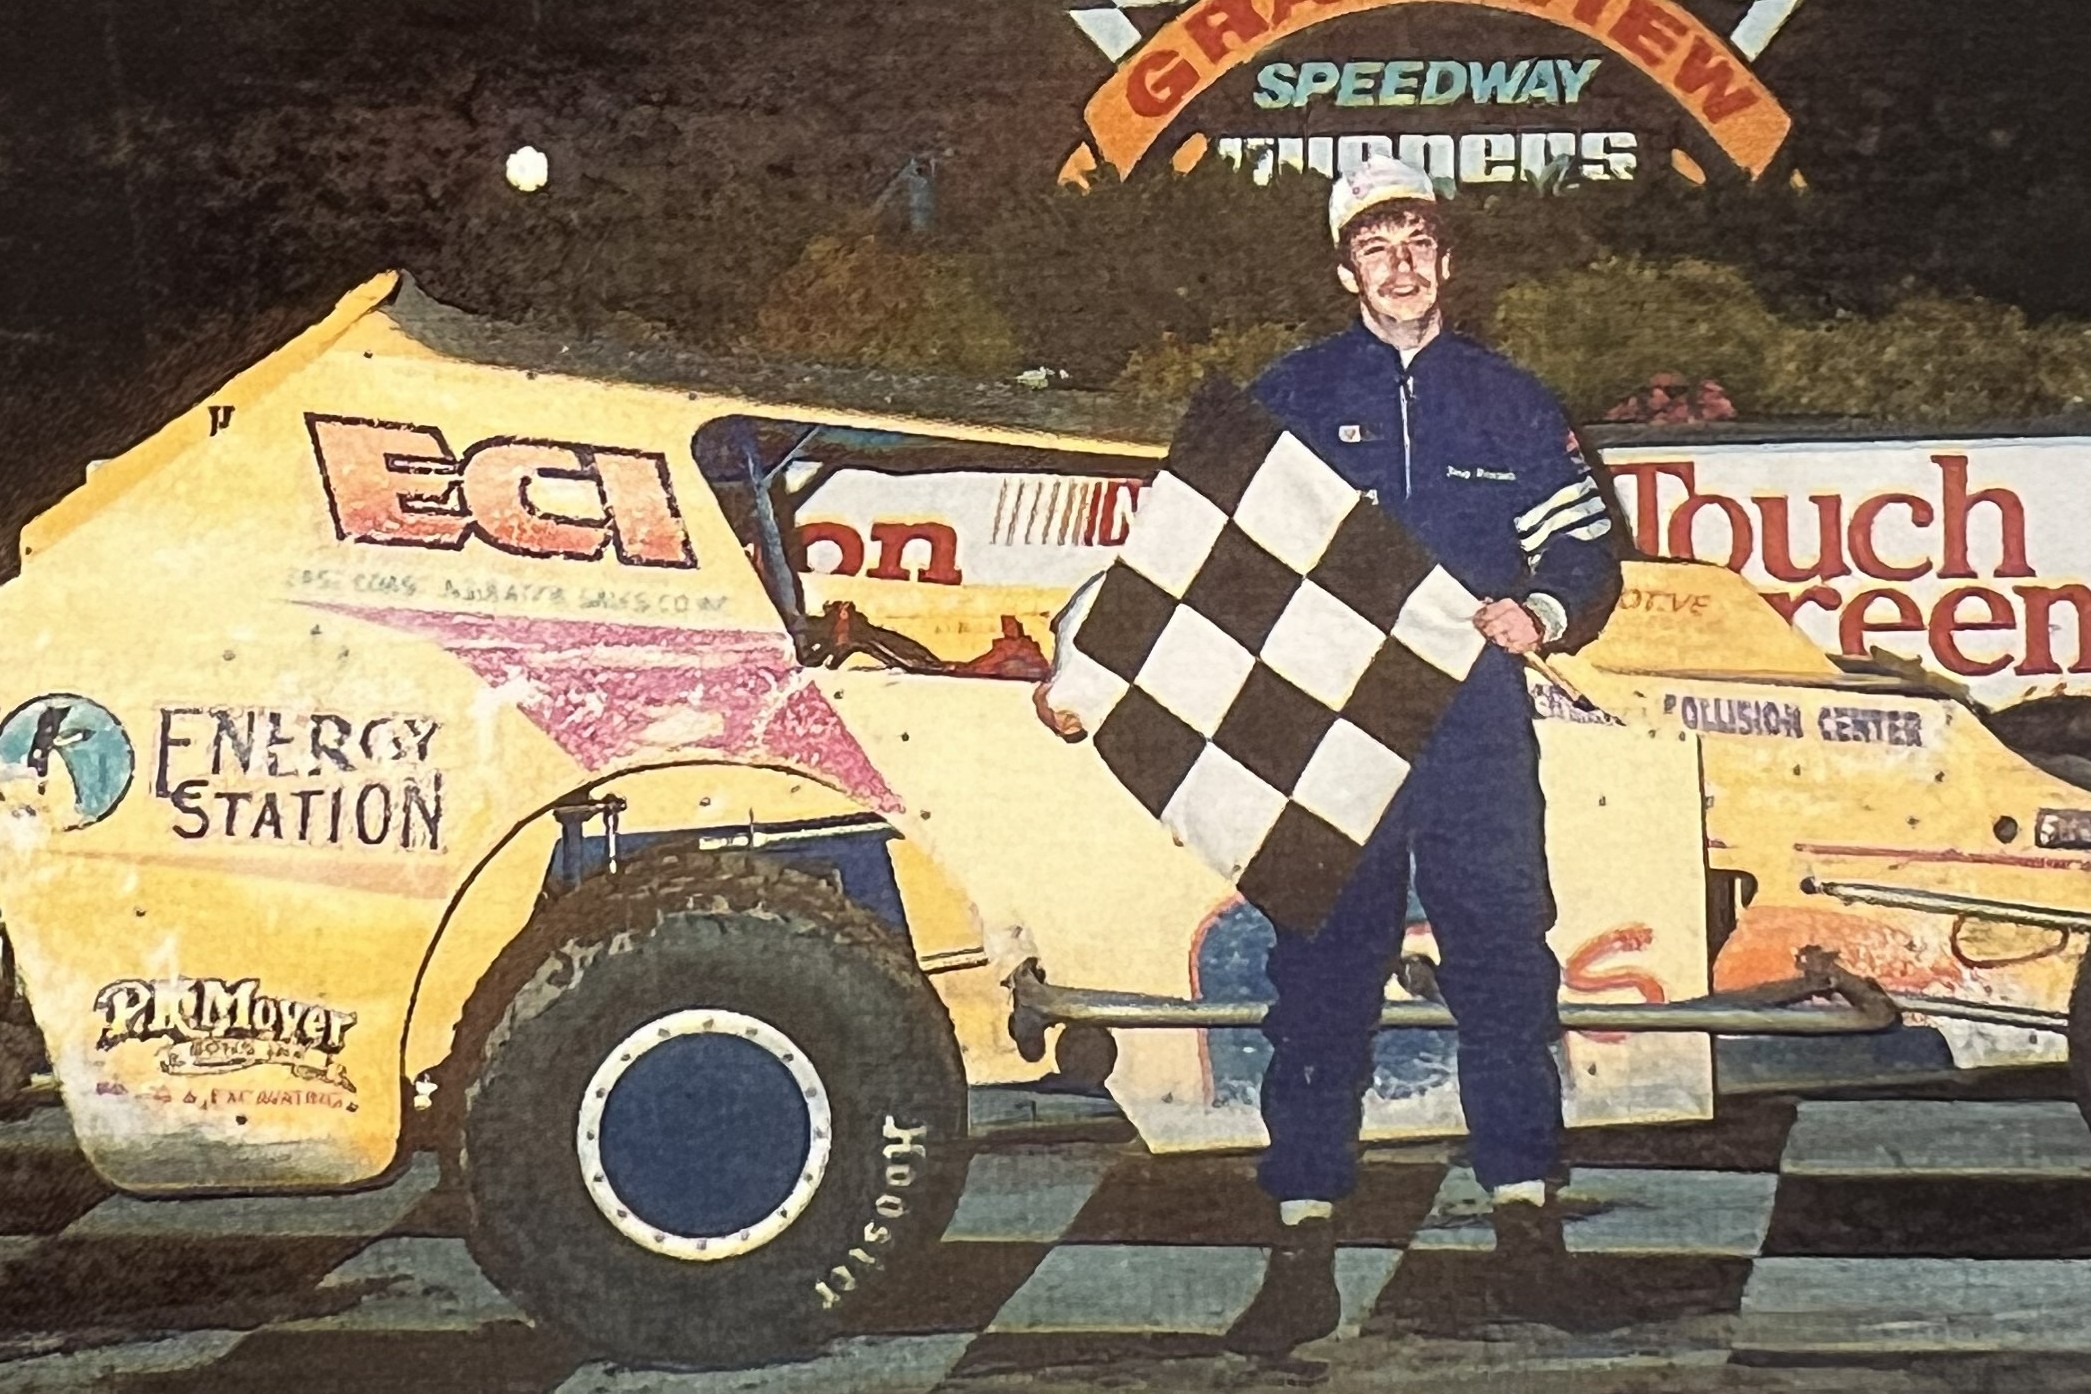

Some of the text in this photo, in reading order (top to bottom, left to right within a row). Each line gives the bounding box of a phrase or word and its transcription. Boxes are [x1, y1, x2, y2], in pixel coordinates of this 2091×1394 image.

[1253, 60, 1602, 108] SPEEDWAY
[304, 411, 700, 569] ECI
[1609, 454, 2037, 582] Touch
[154, 706, 441, 798] ENERGY
[1817, 706, 1924, 747] CENTER
[172, 770, 448, 852] STATION
